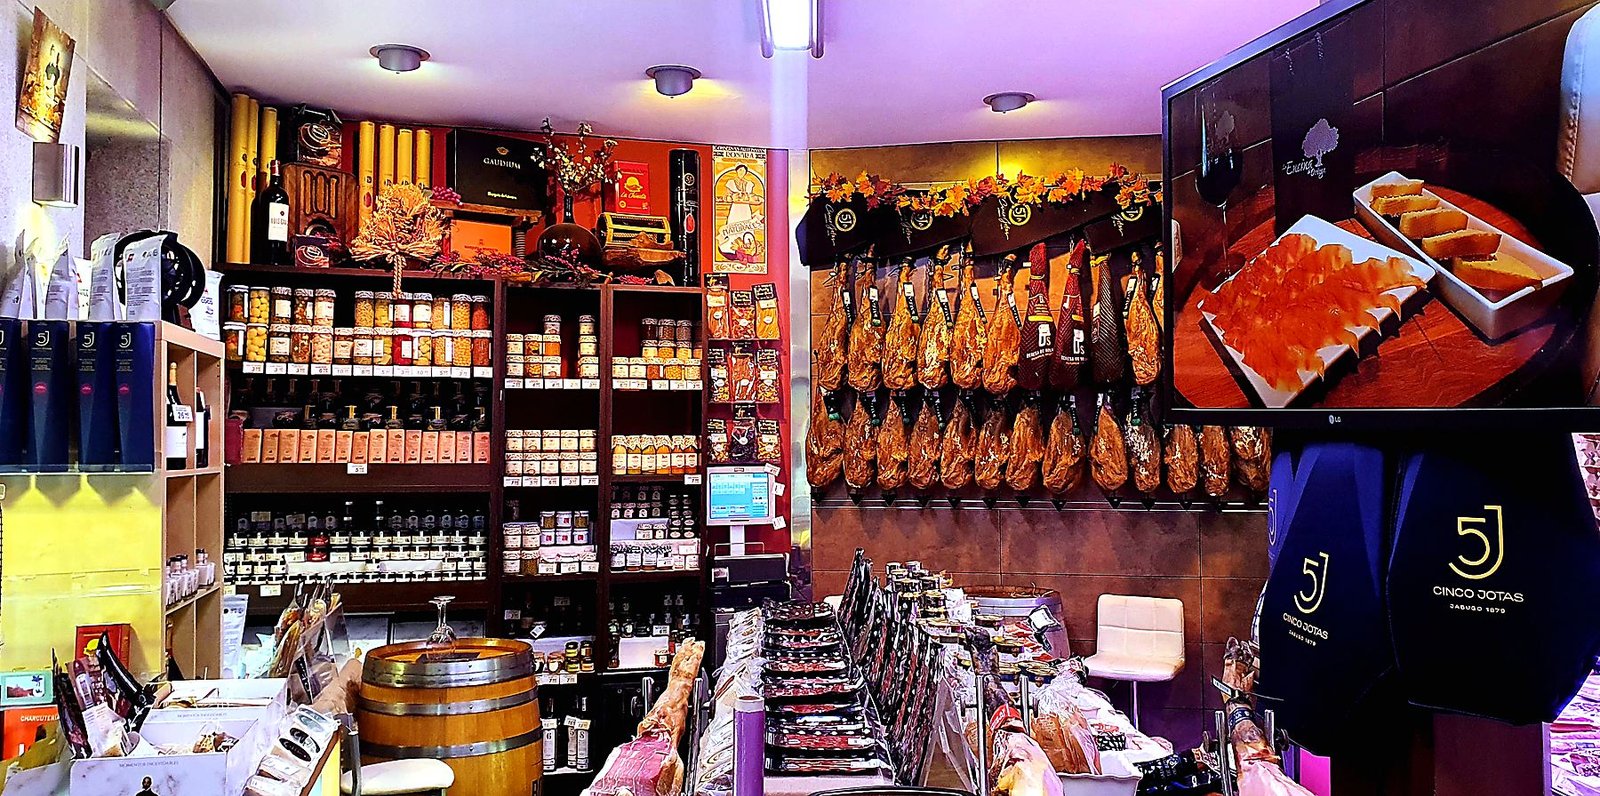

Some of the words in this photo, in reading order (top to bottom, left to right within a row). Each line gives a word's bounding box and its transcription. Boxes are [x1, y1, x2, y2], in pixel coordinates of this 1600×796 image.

[483, 157, 521, 169] GAUDIUM
[1286, 159, 1313, 175] Encina
[35, 330, 50, 347] 5J
[81, 331, 95, 348] 5J
[118, 332, 132, 348] 5J
[1448, 505, 1504, 580] 5J
[1293, 551, 1329, 614] 5J
[1433, 585, 1475, 598] CINCO
[1477, 589, 1524, 603] JOTAS
[1449, 603, 1483, 612] JABUGO
[1282, 612, 1303, 628] CINCO
[1302, 622, 1329, 640] JOTAS
